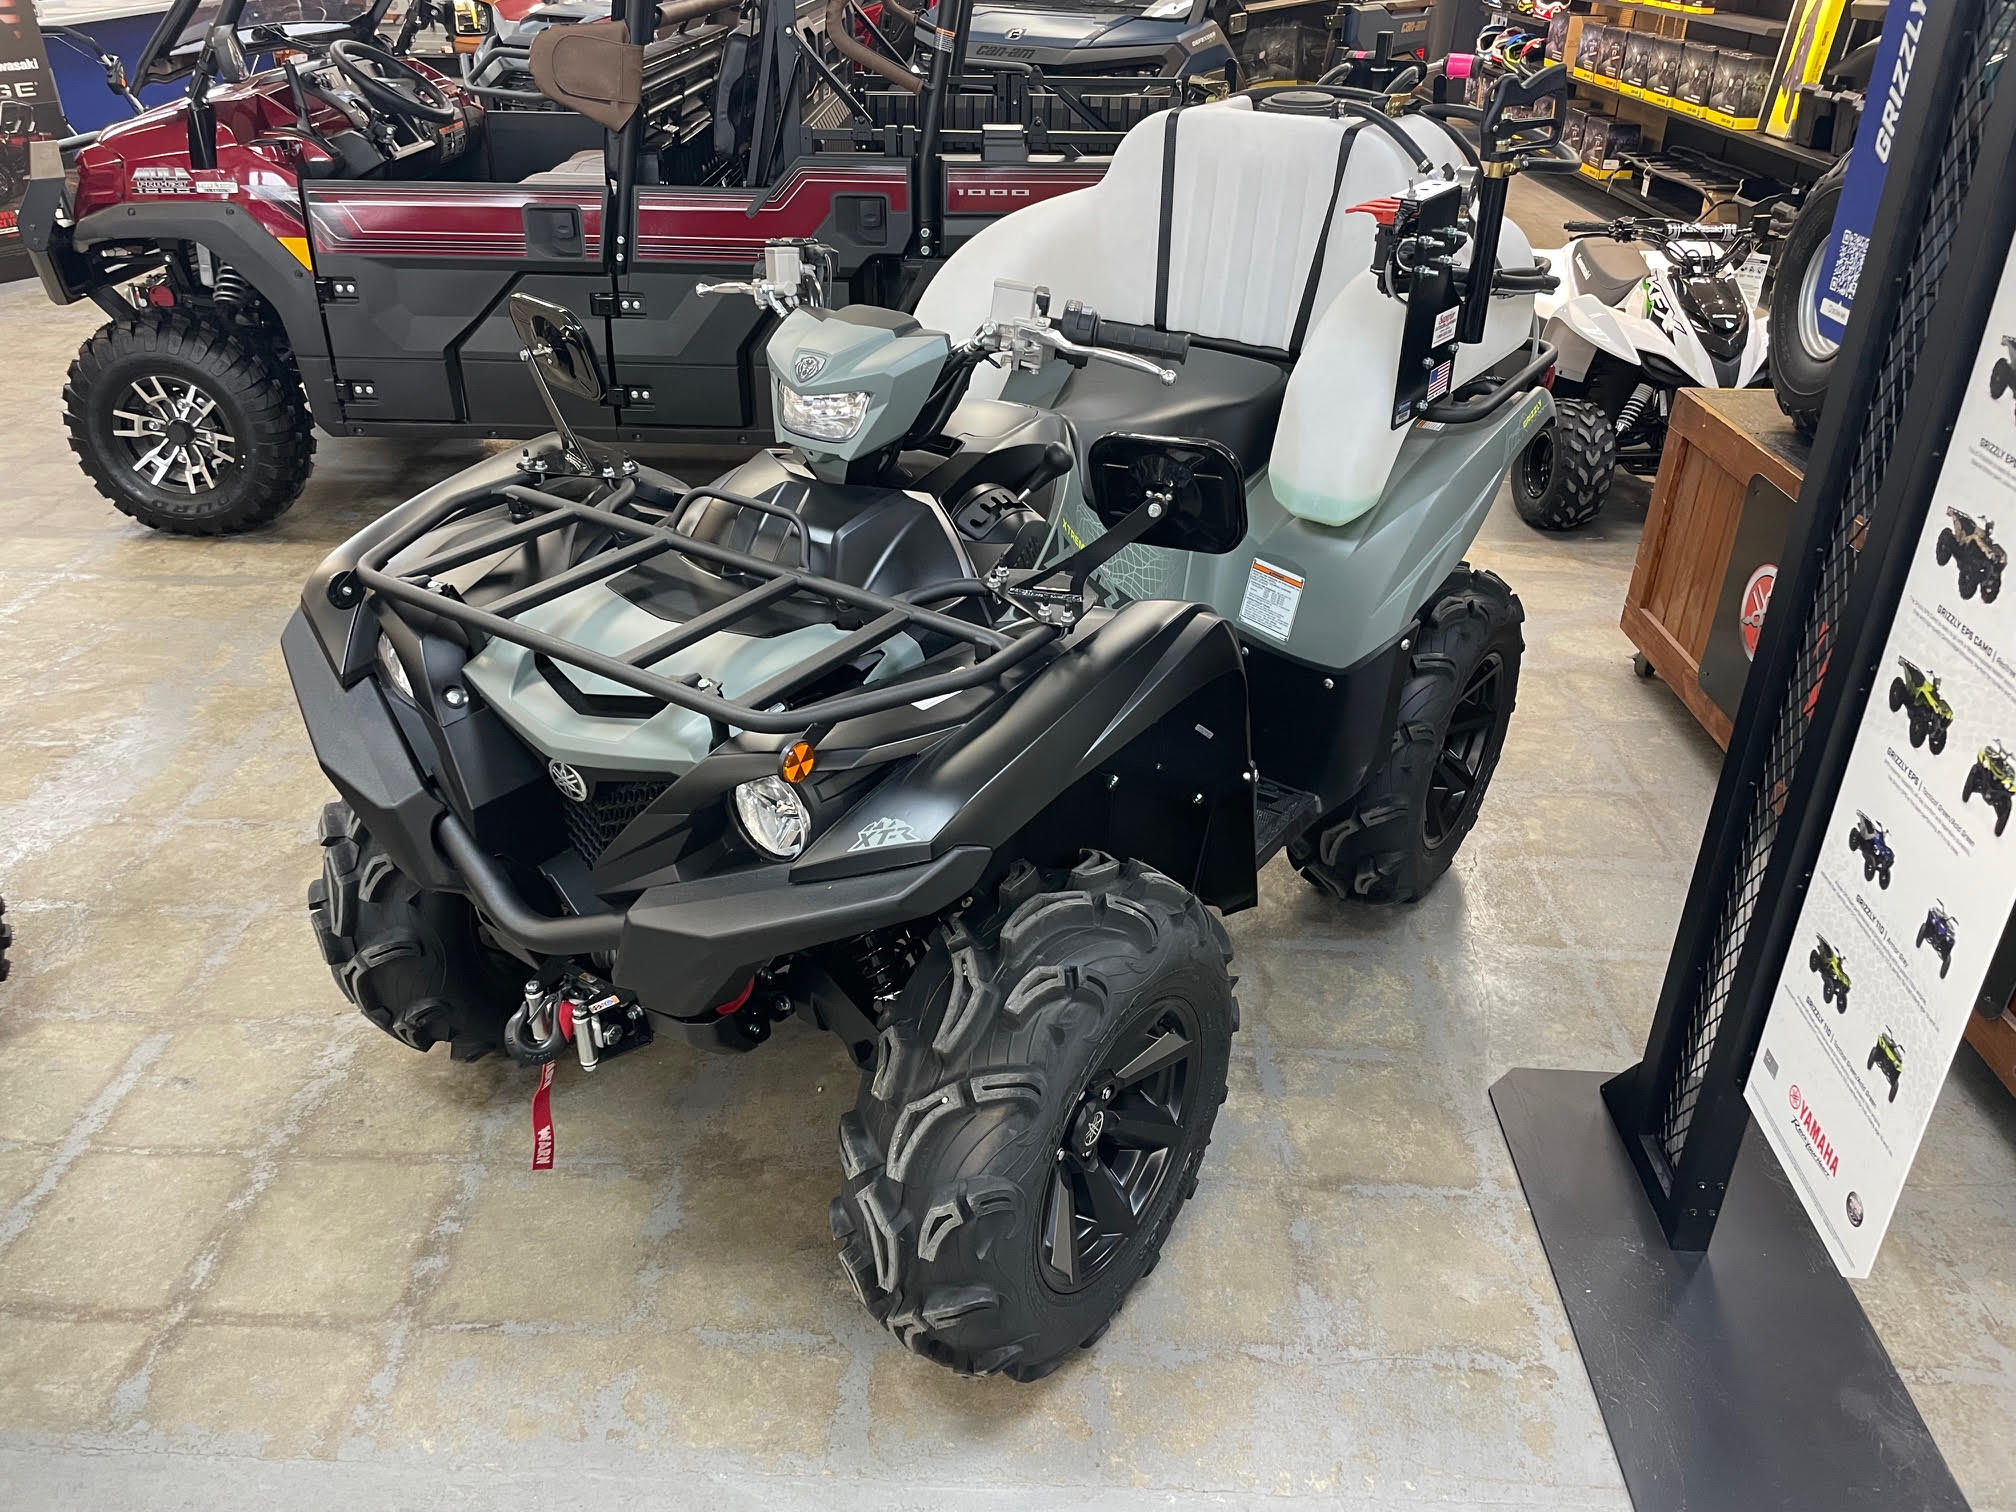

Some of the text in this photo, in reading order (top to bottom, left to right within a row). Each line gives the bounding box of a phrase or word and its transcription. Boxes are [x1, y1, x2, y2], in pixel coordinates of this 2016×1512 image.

[976, 45, 1036, 59] can-am
[1875, 0, 1927, 164] GRIZZLY
[1936, 604, 1993, 656] GRIZZLY EPS CAMO
[1886, 746, 1909, 772] GRIZZLY
[1907, 769, 1920, 786] EPS
[1856, 894, 1876, 922] GRIZZLY
[536, 1124, 552, 1164] WARN
[1799, 1099, 1840, 1178] YAMAHA
